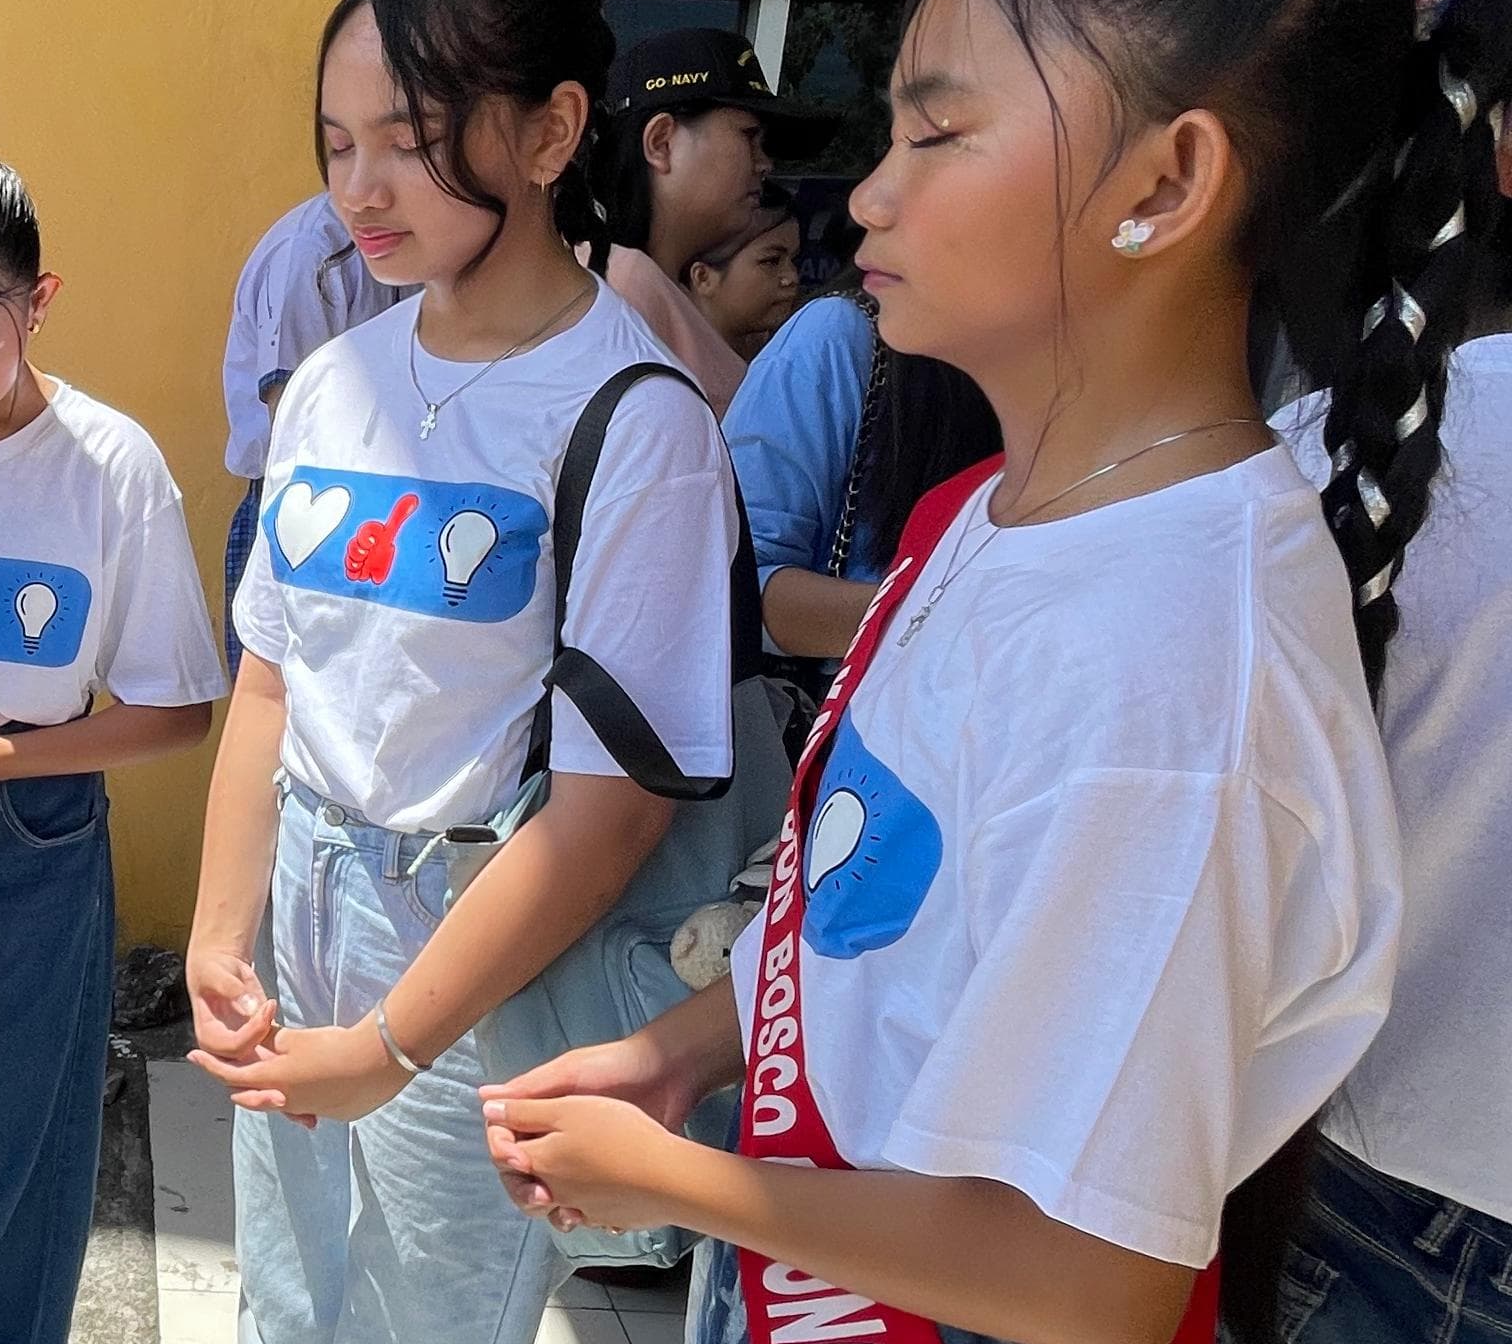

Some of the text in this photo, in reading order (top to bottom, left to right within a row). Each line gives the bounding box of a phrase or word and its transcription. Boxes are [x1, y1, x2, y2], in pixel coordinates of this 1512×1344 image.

[645, 71, 710, 91] GO NAVY
[752, 930, 799, 1136] BOSCO
